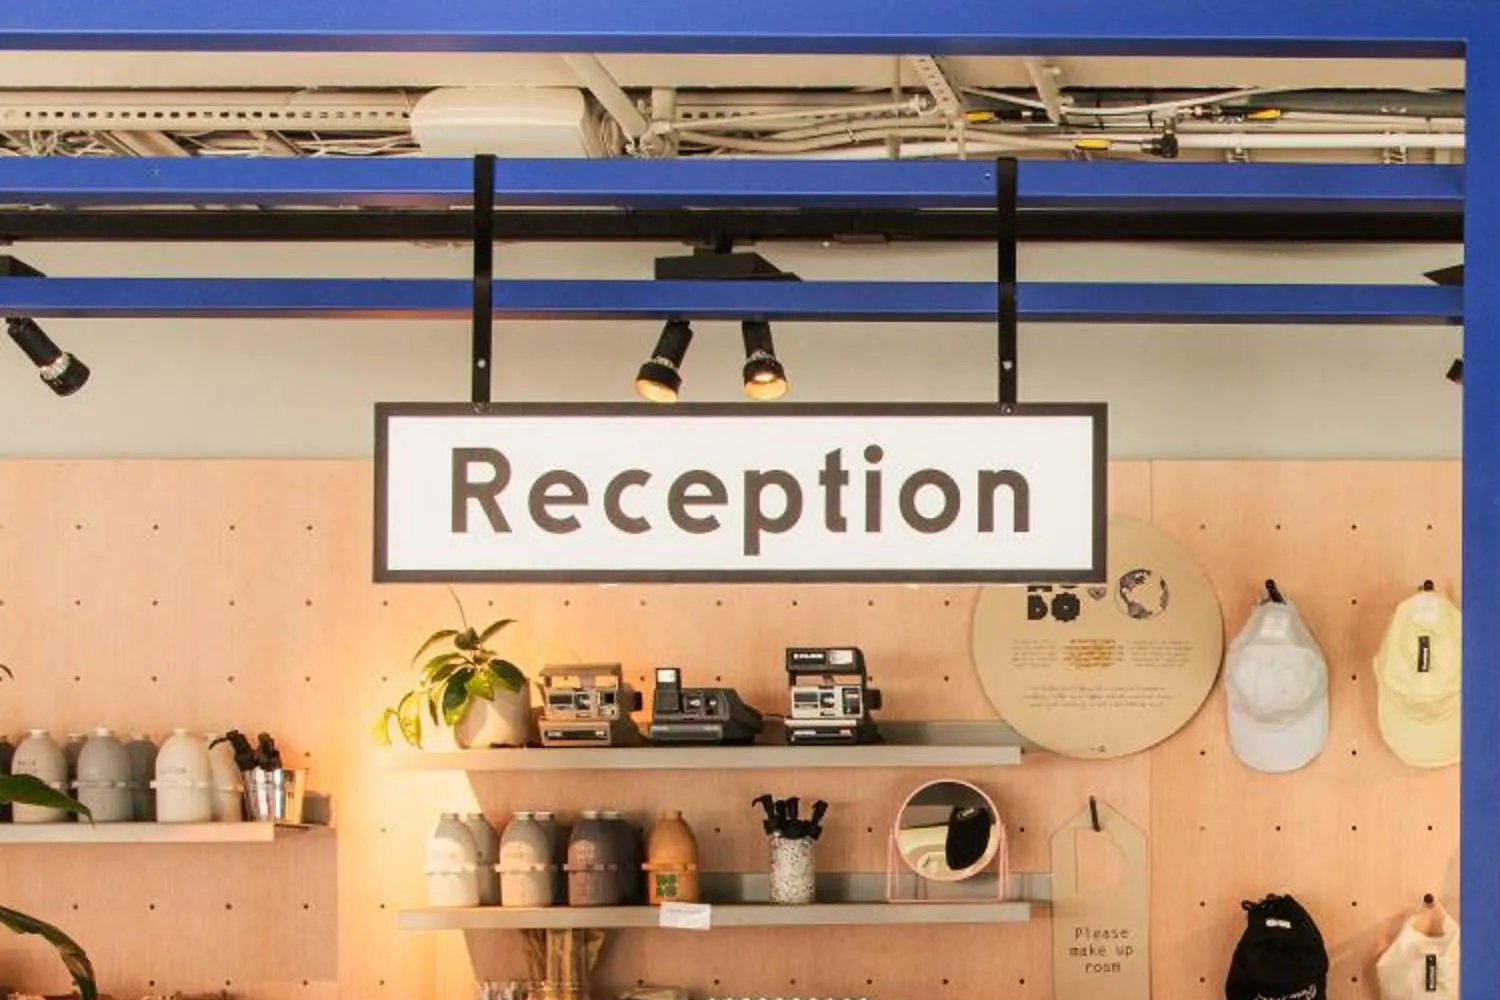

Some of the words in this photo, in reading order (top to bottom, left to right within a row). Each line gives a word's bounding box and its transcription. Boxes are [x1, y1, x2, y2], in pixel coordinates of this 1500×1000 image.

[450, 443, 1031, 556] Reception
[1074, 926, 1130, 941] Please
[1069, 944, 1107, 957] make
[1116, 945, 1134, 959] up
[1084, 961, 1121, 974] room
